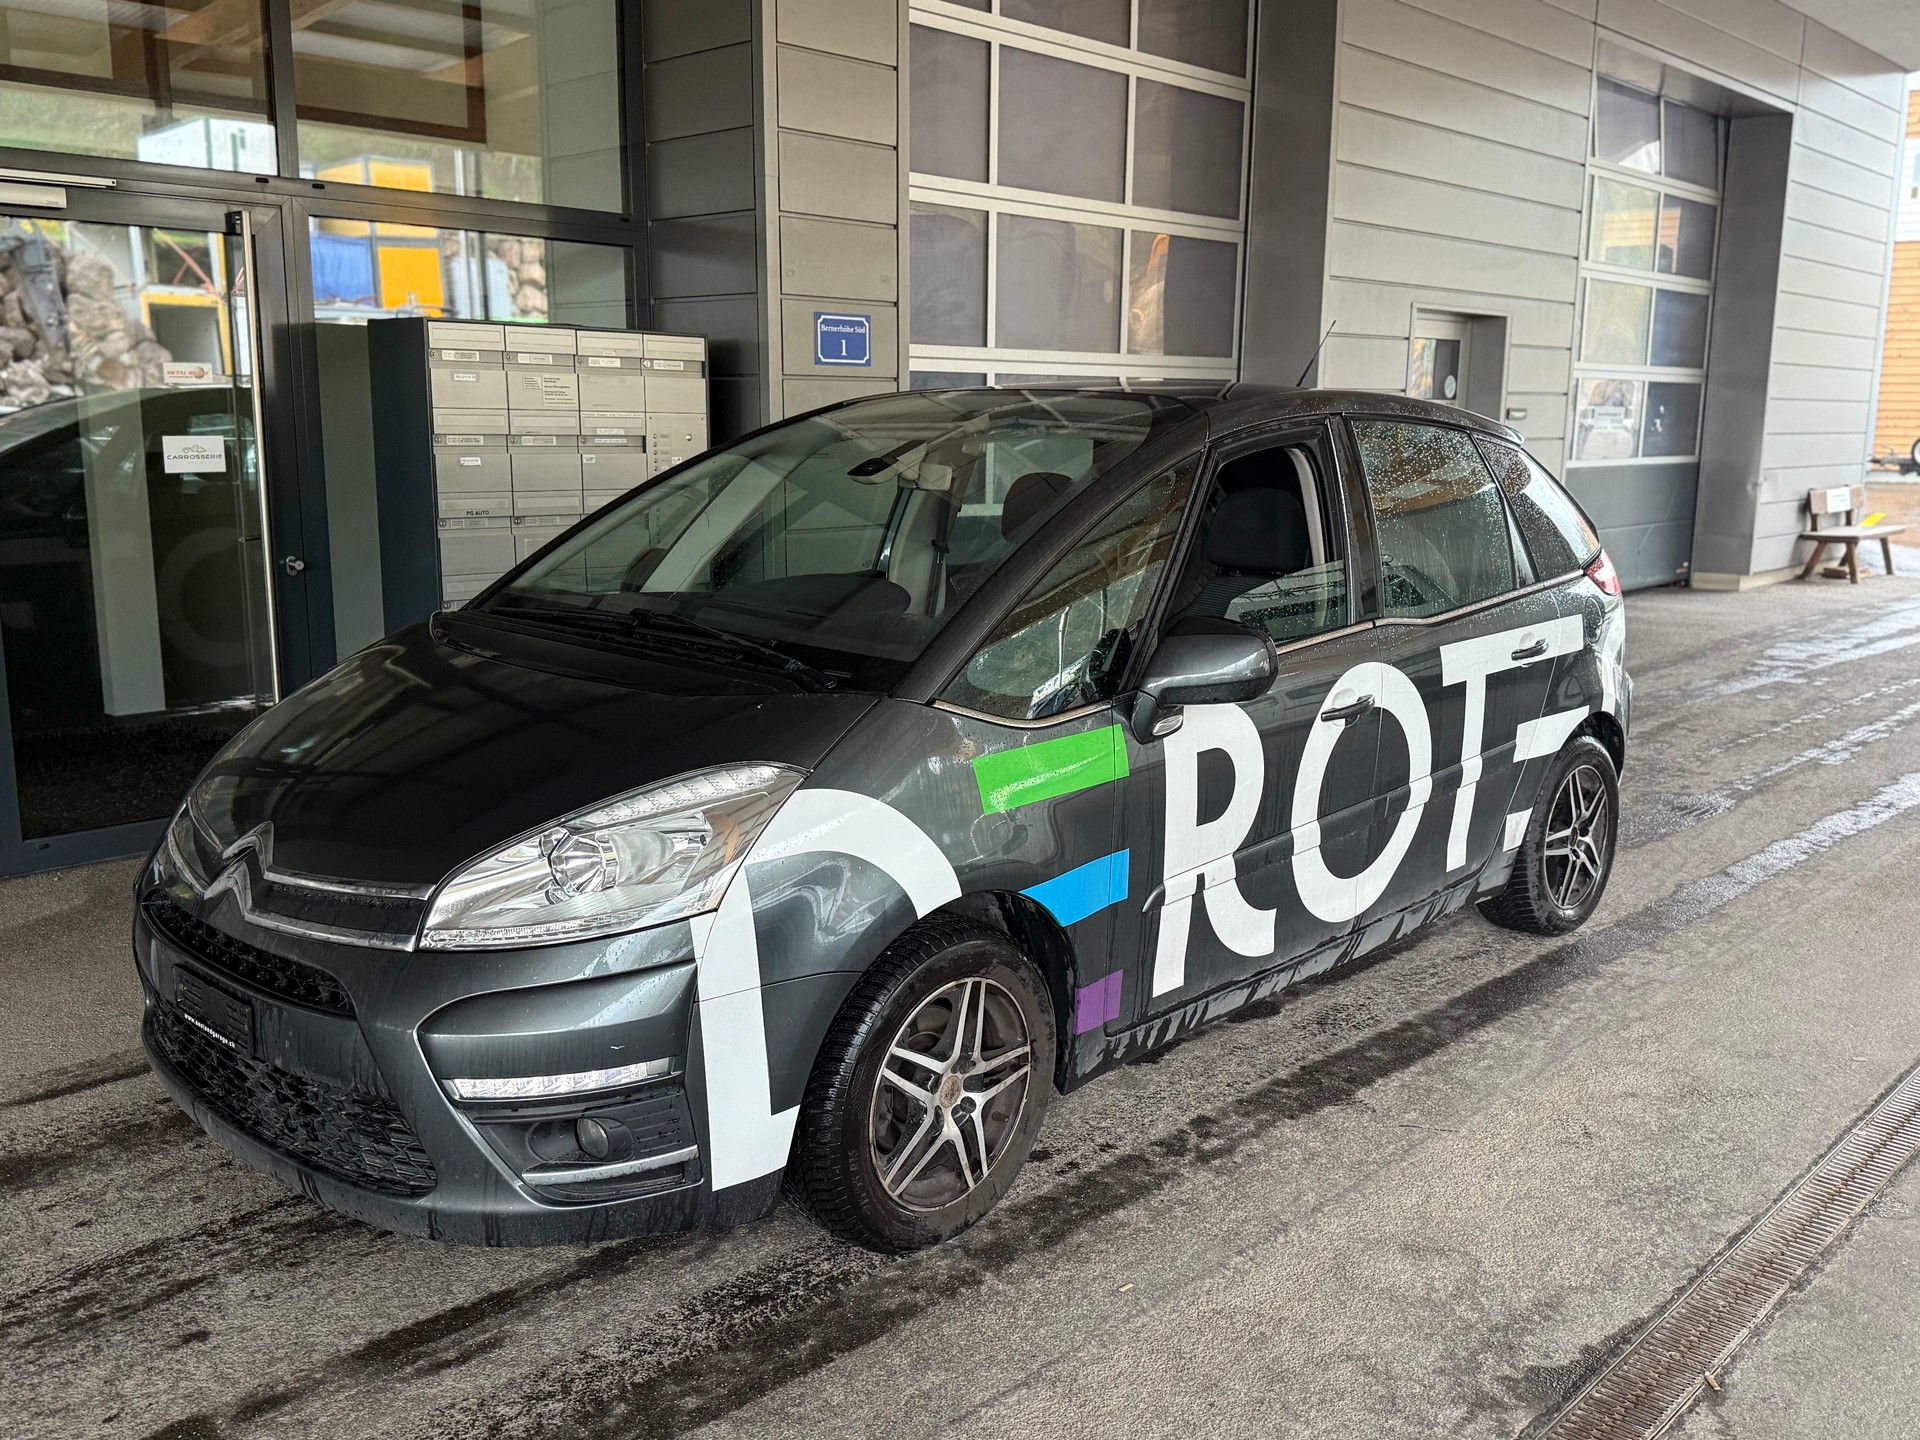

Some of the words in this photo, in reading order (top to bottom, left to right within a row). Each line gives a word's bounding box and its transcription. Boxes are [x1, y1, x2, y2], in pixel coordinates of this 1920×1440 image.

[821, 324, 854, 333] Bernerhöhe
[854, 326, 866, 334] Süd
[840, 339, 847, 356] 1
